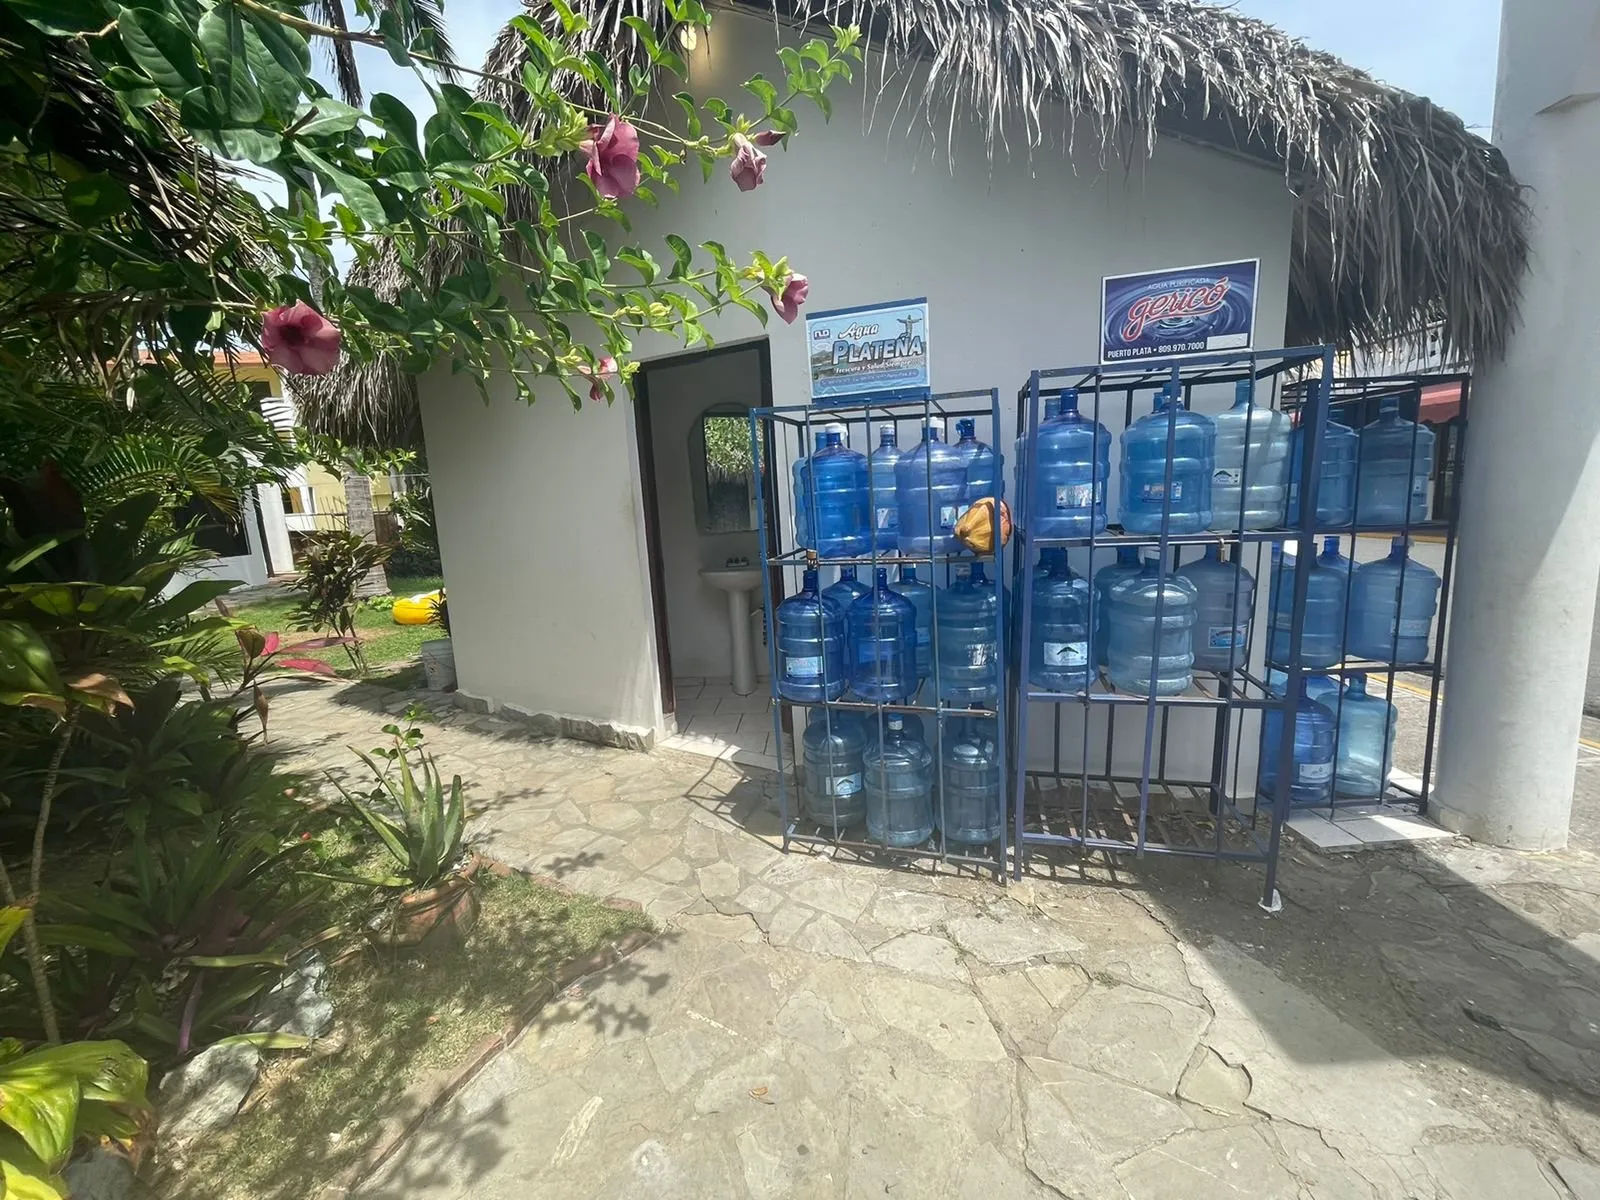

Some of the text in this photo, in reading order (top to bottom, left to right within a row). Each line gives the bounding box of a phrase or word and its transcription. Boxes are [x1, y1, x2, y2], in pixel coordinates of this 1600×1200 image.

[838, 322, 879, 340] Agua
[833, 333, 922, 365] PLATEÑA
[1108, 342, 1204, 358] PUERTO PLATA 809.970.7000
